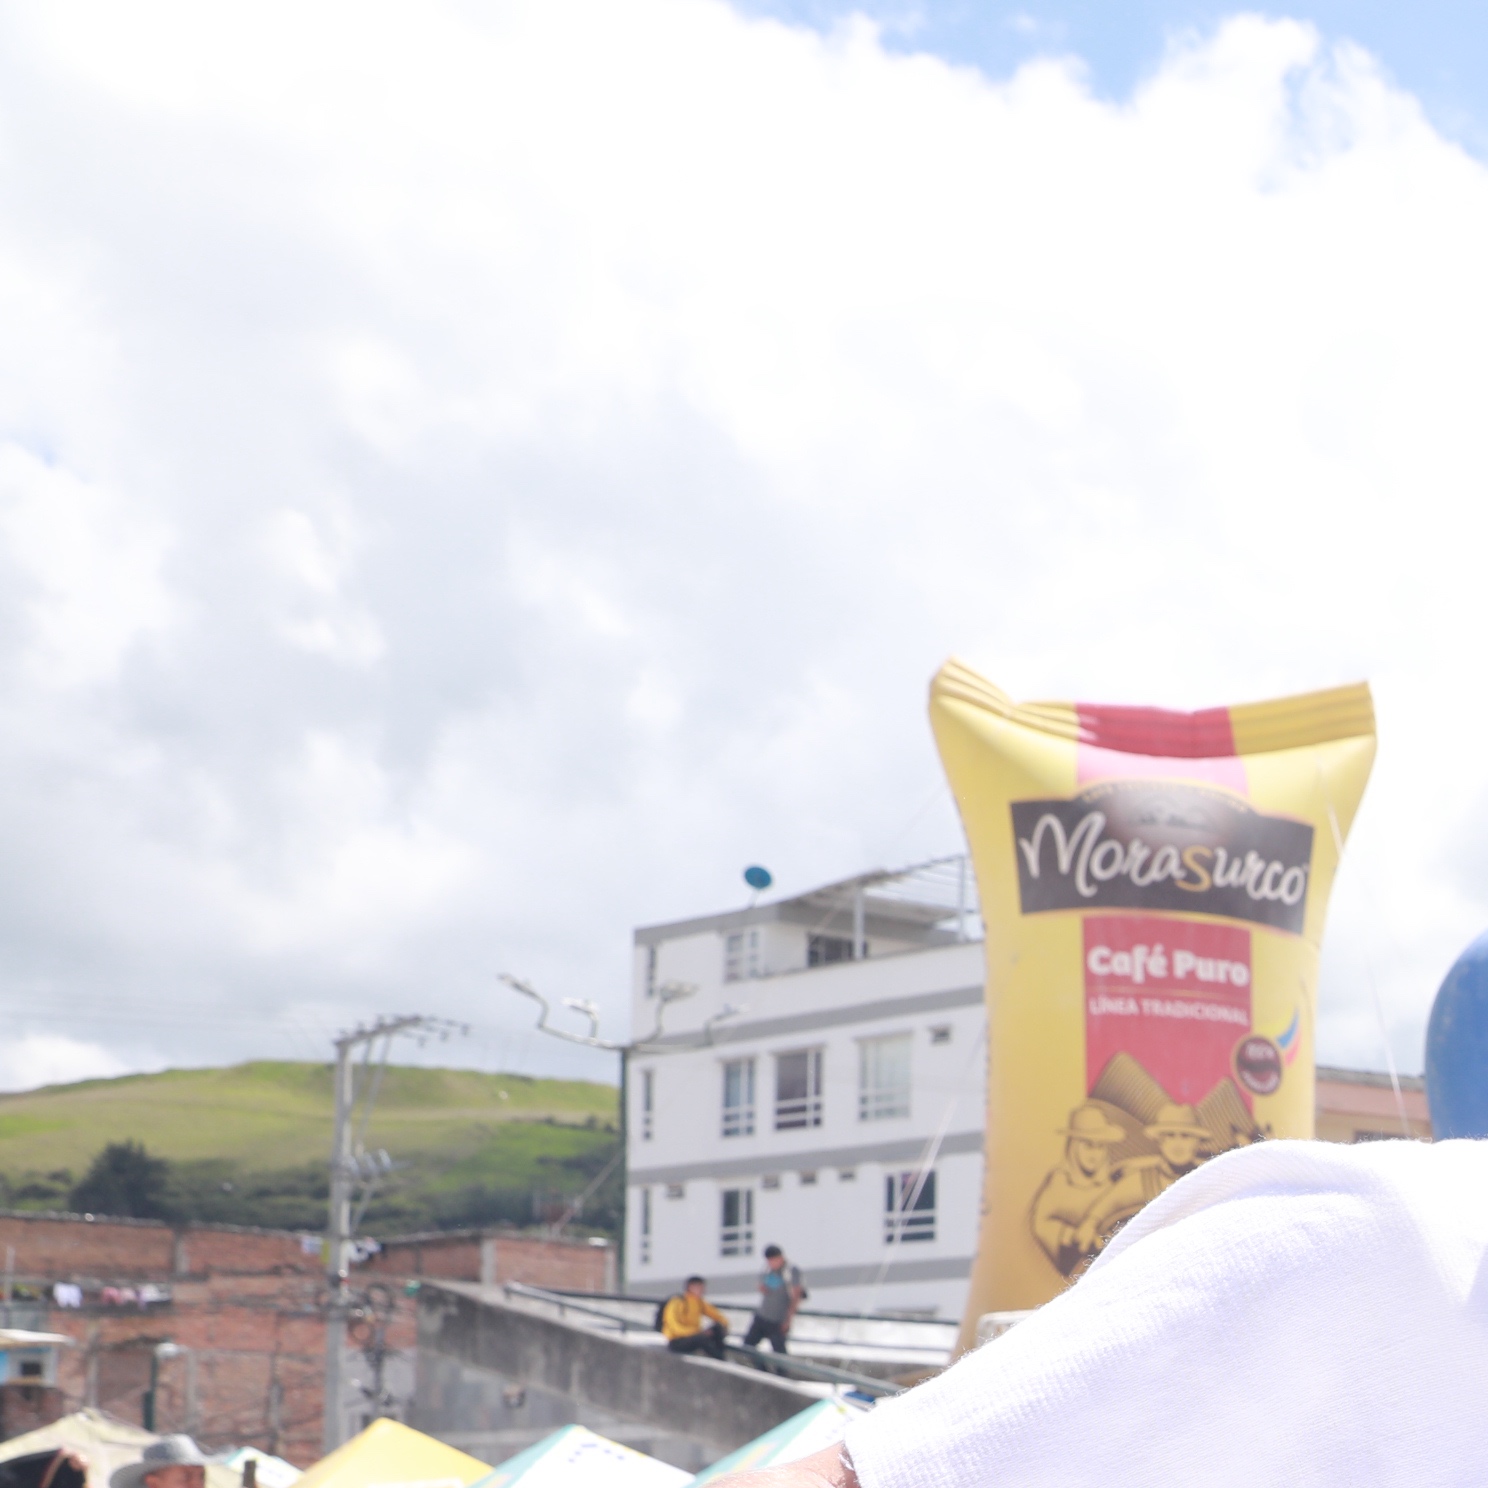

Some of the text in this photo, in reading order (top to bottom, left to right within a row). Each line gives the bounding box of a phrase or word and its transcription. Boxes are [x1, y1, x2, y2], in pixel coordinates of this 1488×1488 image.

[1087, 942, 1249, 986] Café Puro
[1142, 998, 1249, 1026] TRADICIONAL
